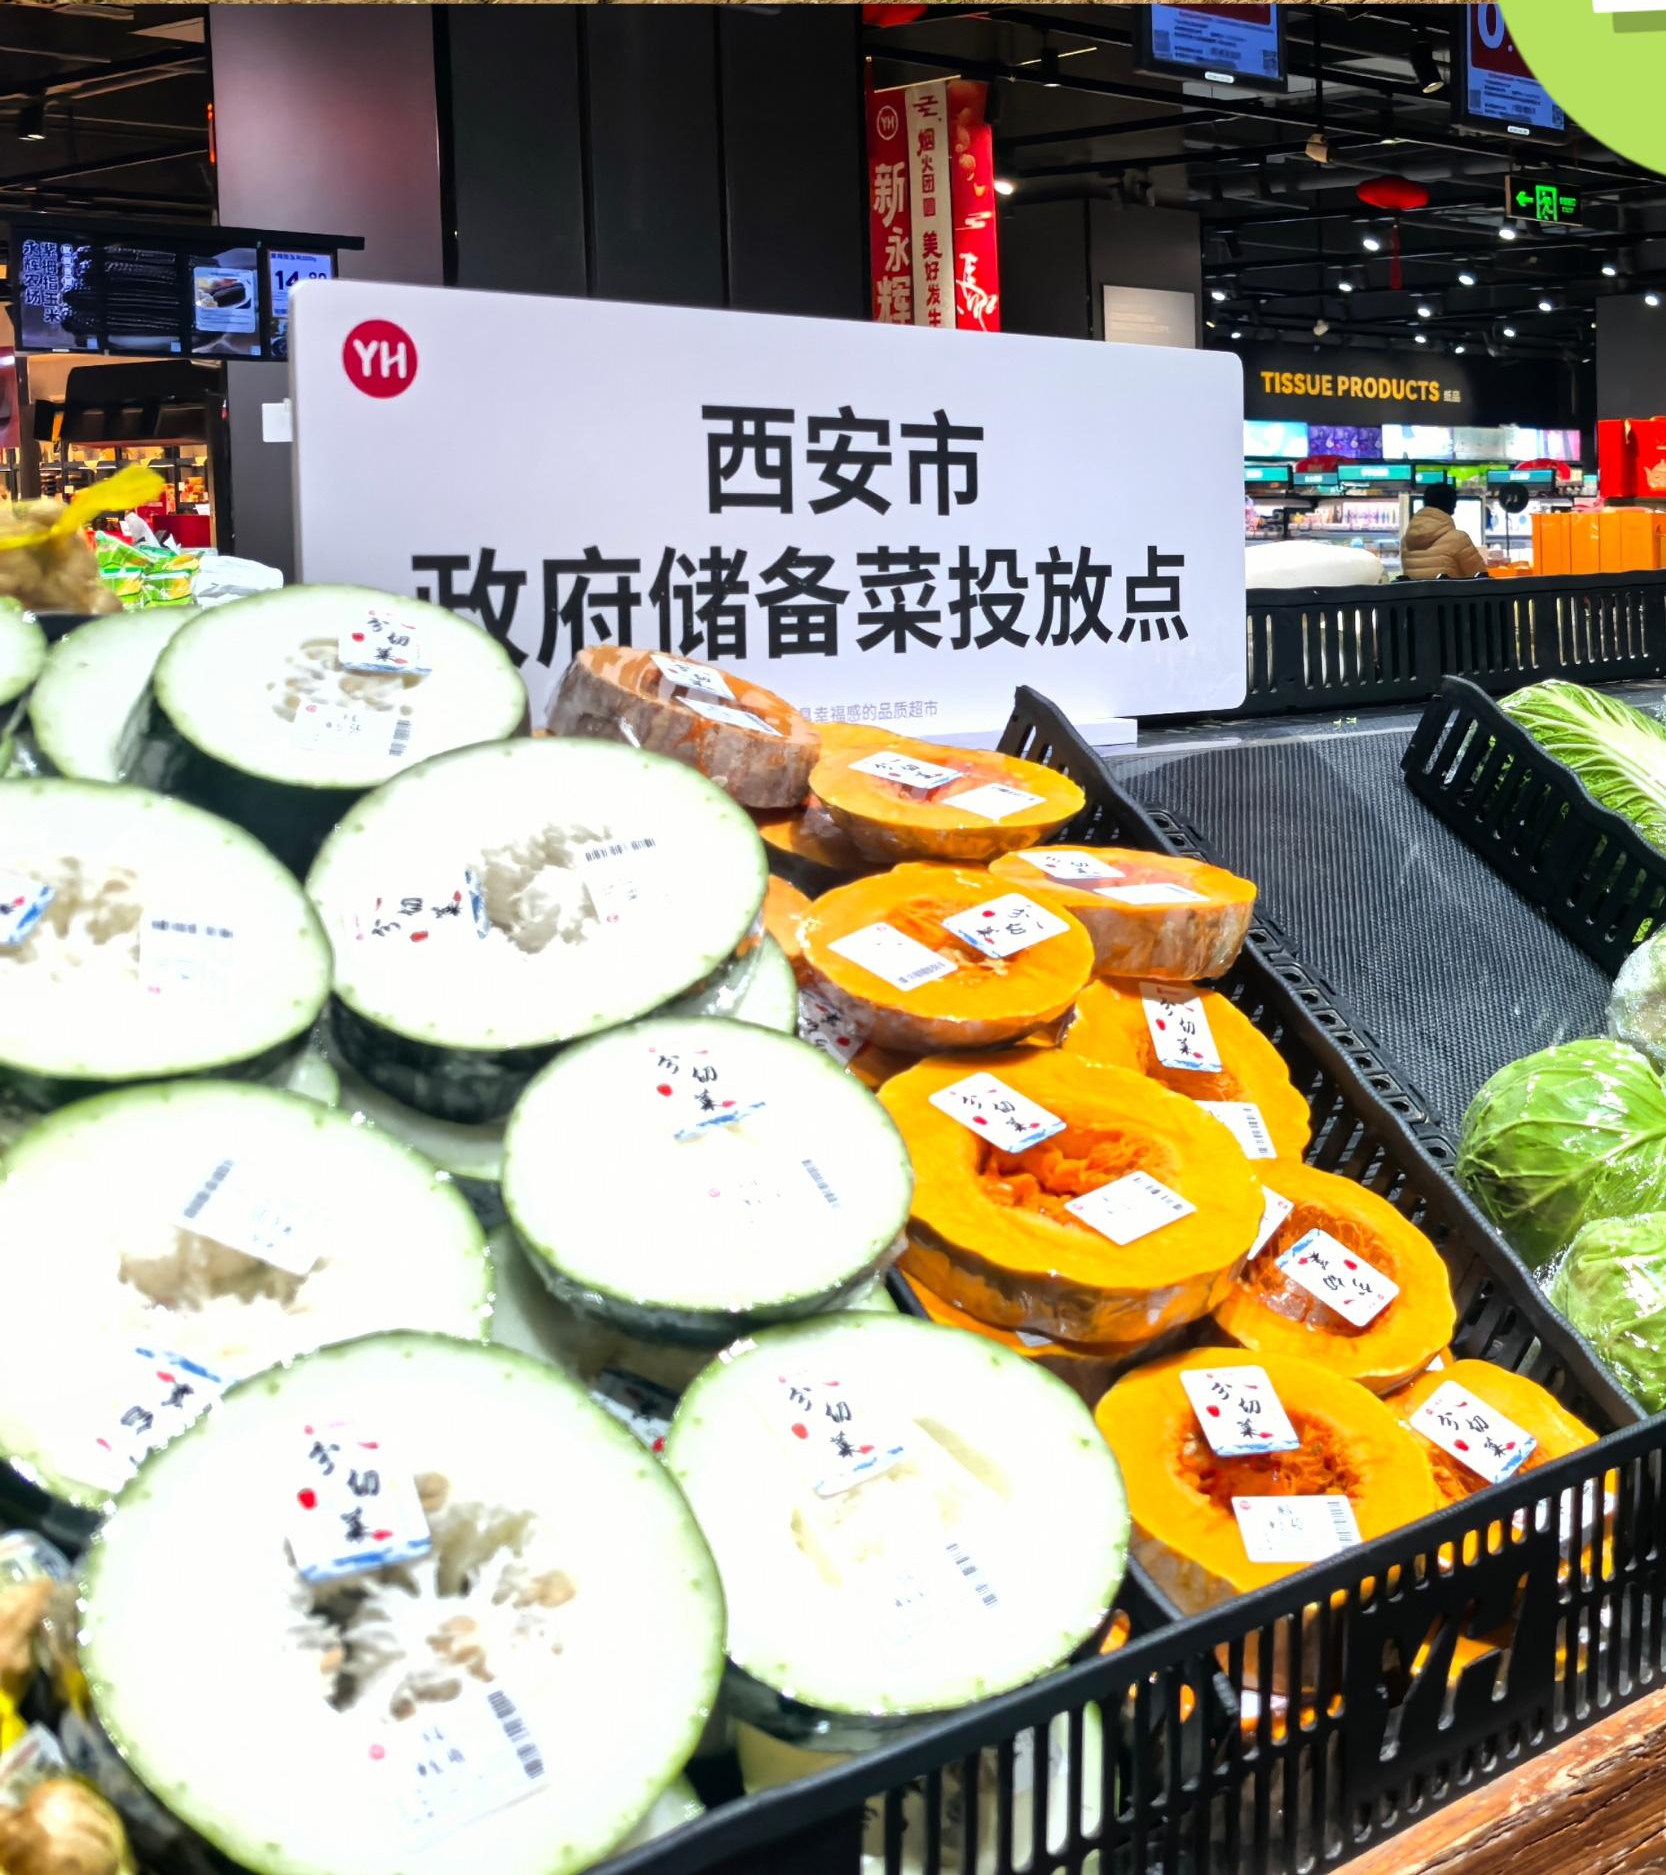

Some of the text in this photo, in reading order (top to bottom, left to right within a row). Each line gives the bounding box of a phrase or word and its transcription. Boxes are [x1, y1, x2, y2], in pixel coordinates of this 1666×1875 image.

[873, 161, 913, 326] 新永辉
[353, 338, 408, 382] YH
[1261, 371, 1333, 397] TISSUE
[1337, 375, 1440, 402] PRODUCTS
[701, 404, 986, 517] 西安市
[410, 544, 1190, 669] 政府储备菜投放点
